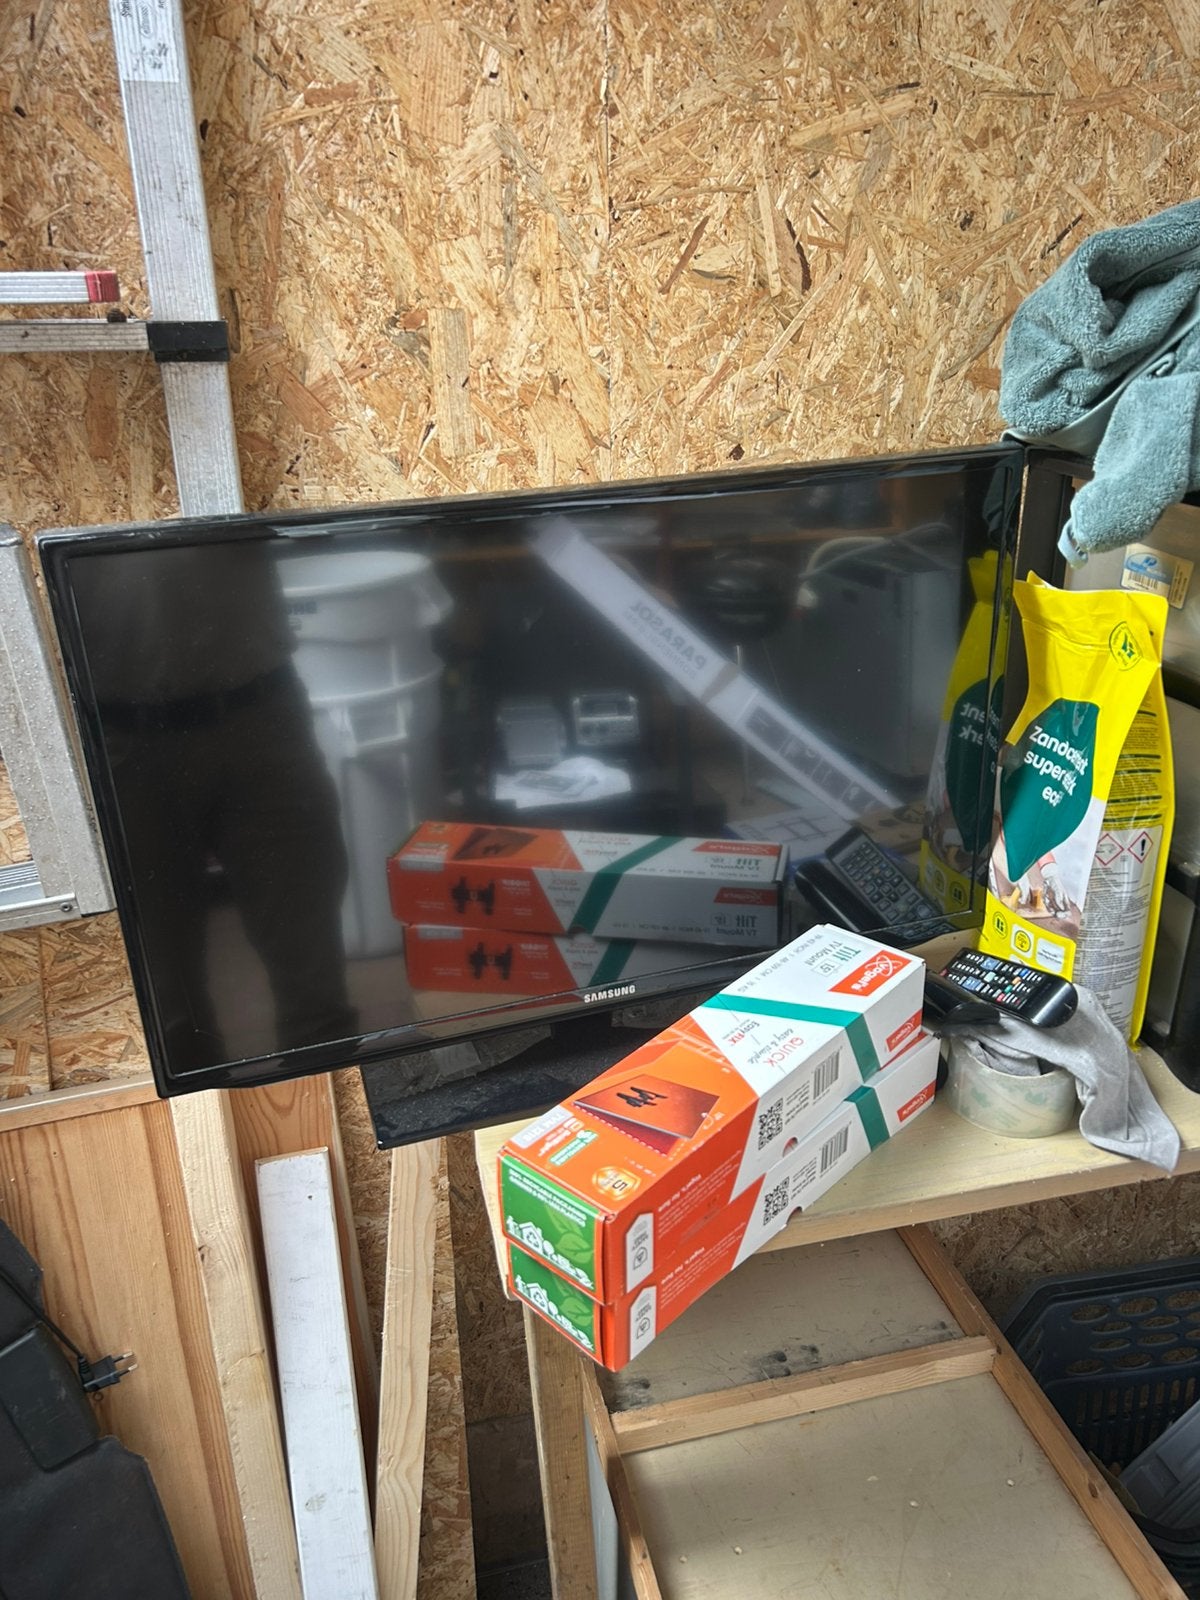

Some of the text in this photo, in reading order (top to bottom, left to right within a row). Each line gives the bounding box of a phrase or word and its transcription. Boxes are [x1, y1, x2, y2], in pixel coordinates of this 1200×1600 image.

[804, 946, 830, 967] Mount
[832, 945, 861, 963] Tilt
[584, 985, 636, 1003] SAMSUNG
[763, 1037, 805, 1067] QUICK
[612, 1180, 628, 1192] 5
